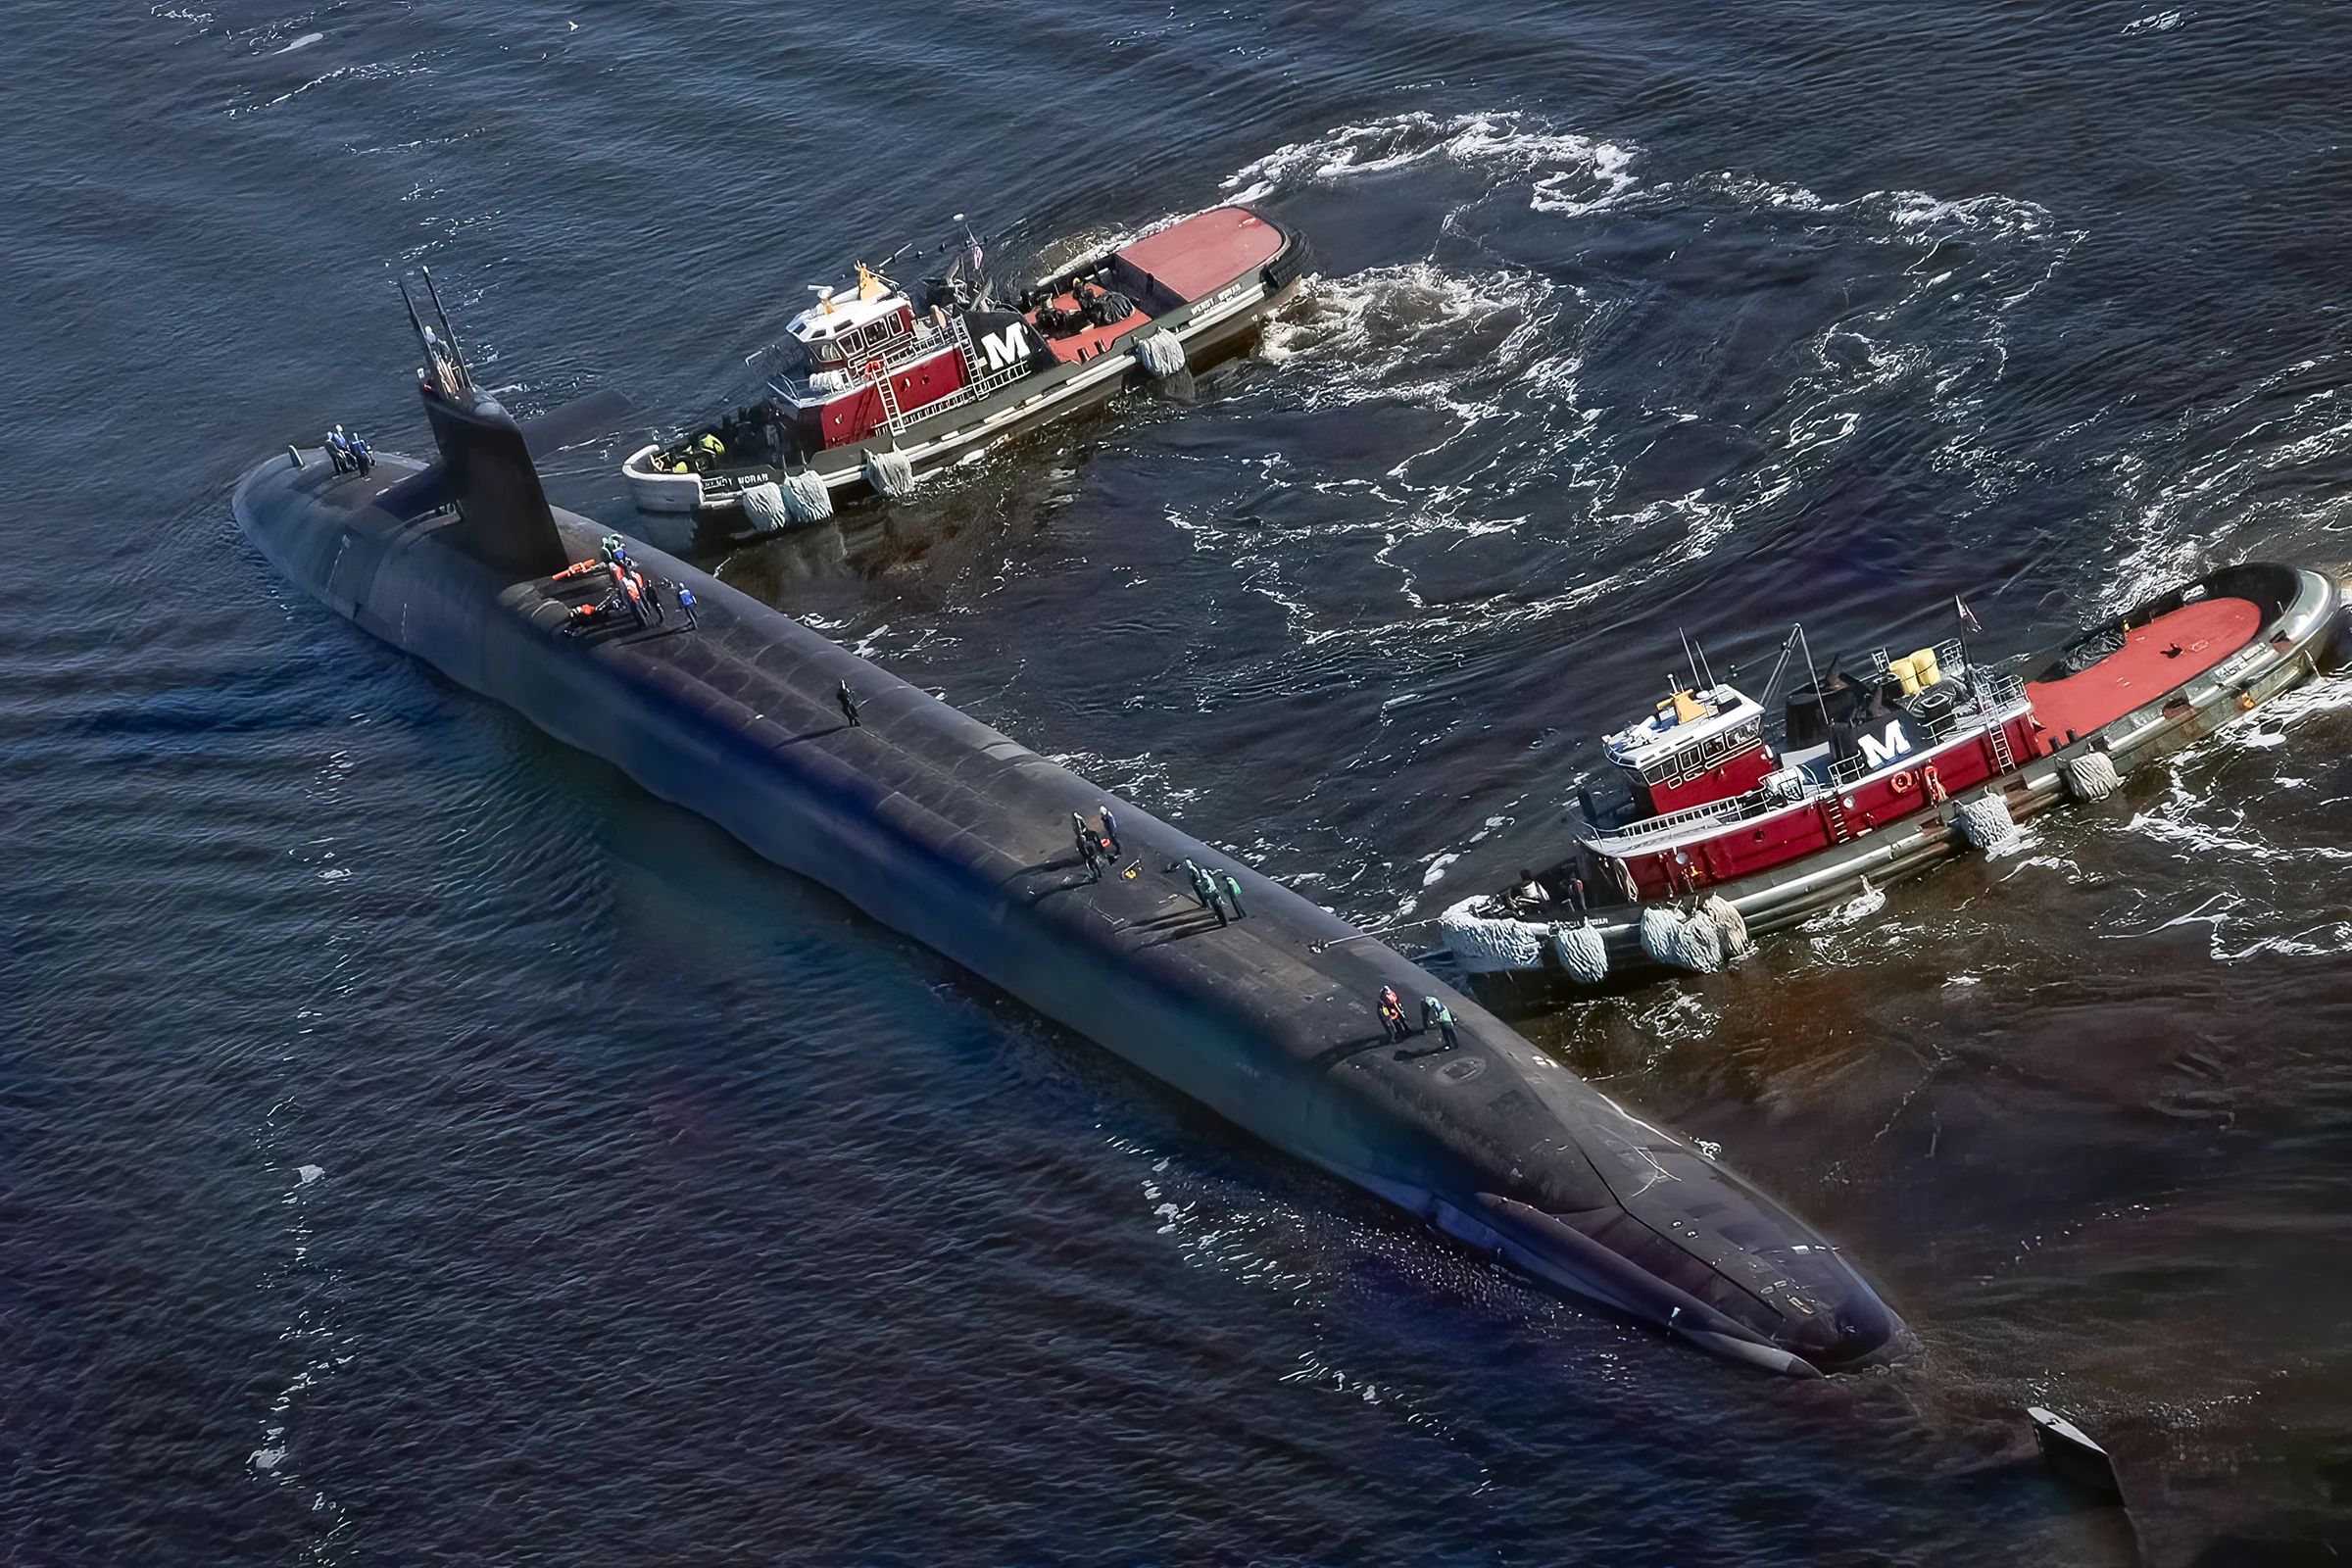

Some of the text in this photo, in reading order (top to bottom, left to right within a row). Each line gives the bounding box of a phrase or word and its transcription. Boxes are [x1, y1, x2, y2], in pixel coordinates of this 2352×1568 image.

[981, 321, 1031, 370] M
[737, 473, 769, 486] MORAN
[1857, 718, 1913, 769] M
